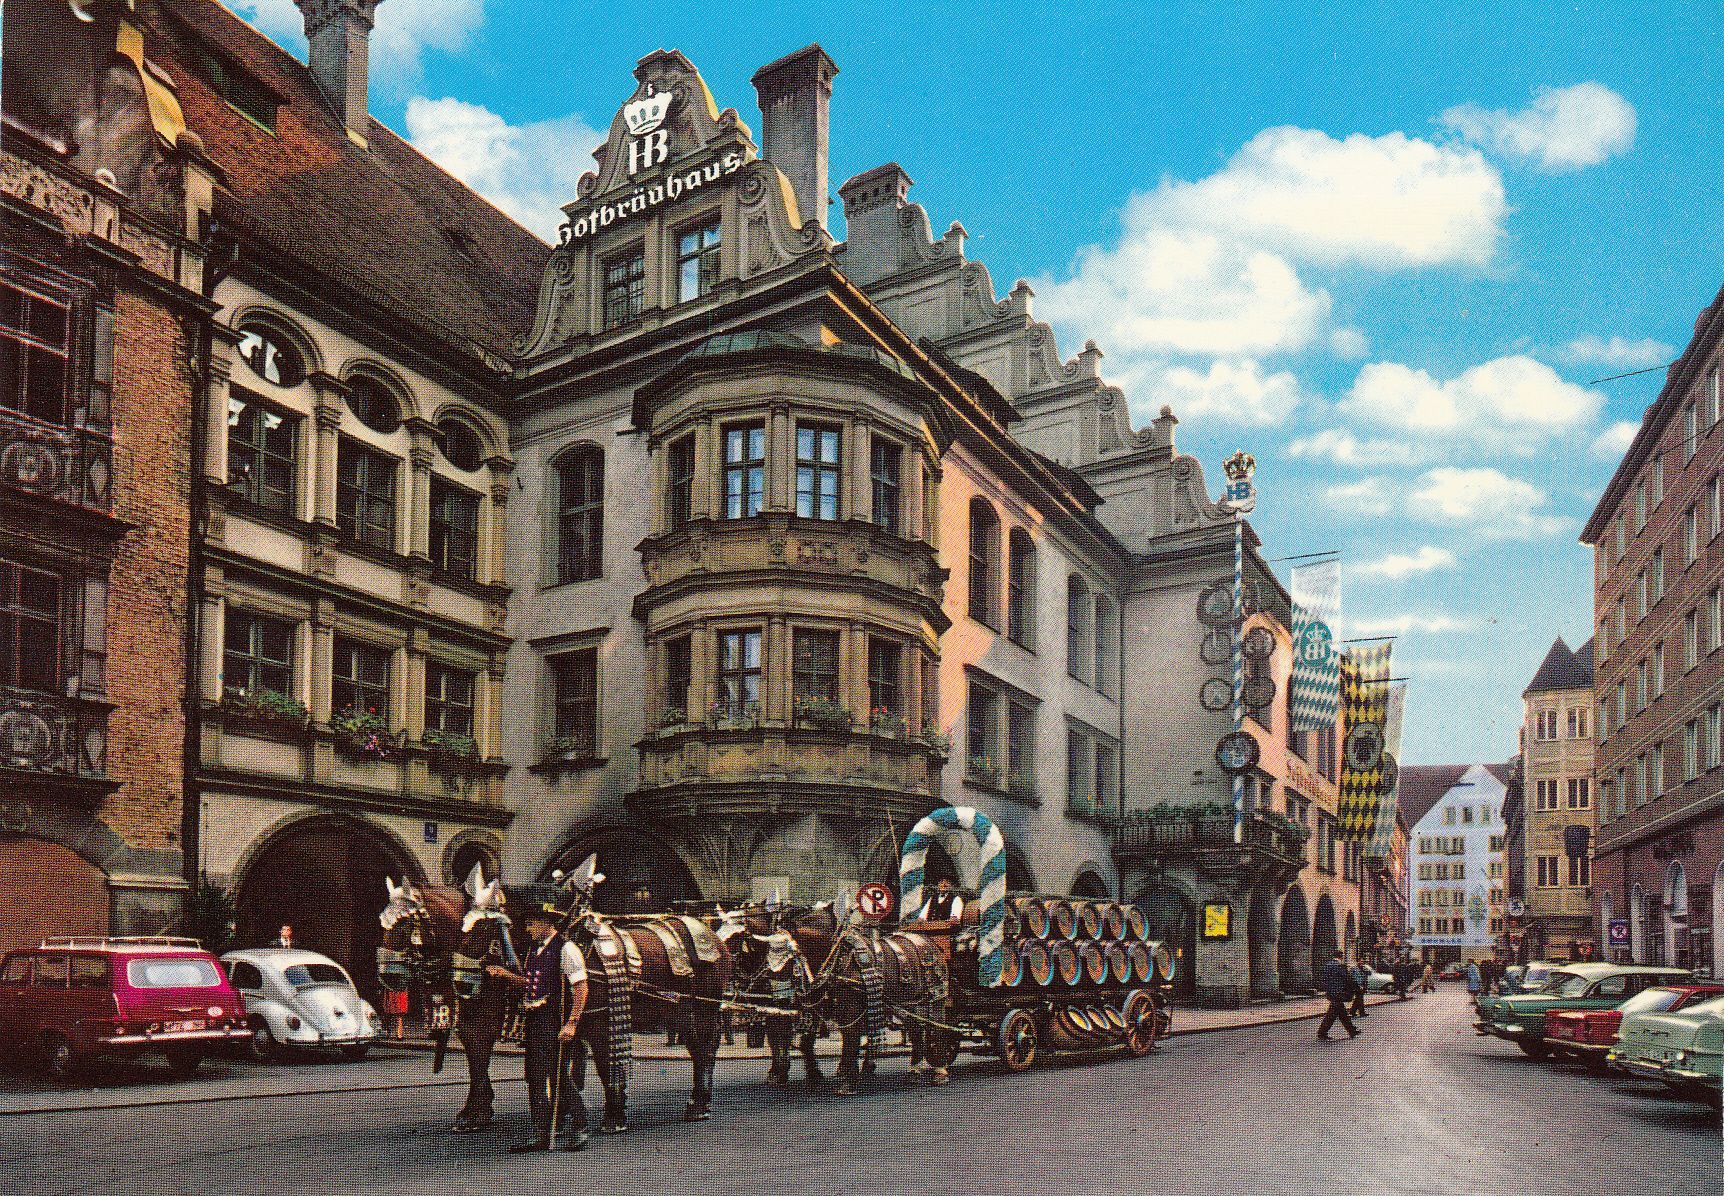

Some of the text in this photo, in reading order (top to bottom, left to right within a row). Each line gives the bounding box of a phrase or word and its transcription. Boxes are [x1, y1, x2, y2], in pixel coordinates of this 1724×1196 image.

[628, 128, 668, 176] HB
[556, 152, 742, 247] Hofbräuhaus
[1227, 482, 1250, 501] HB
[872, 889, 885, 913] P
